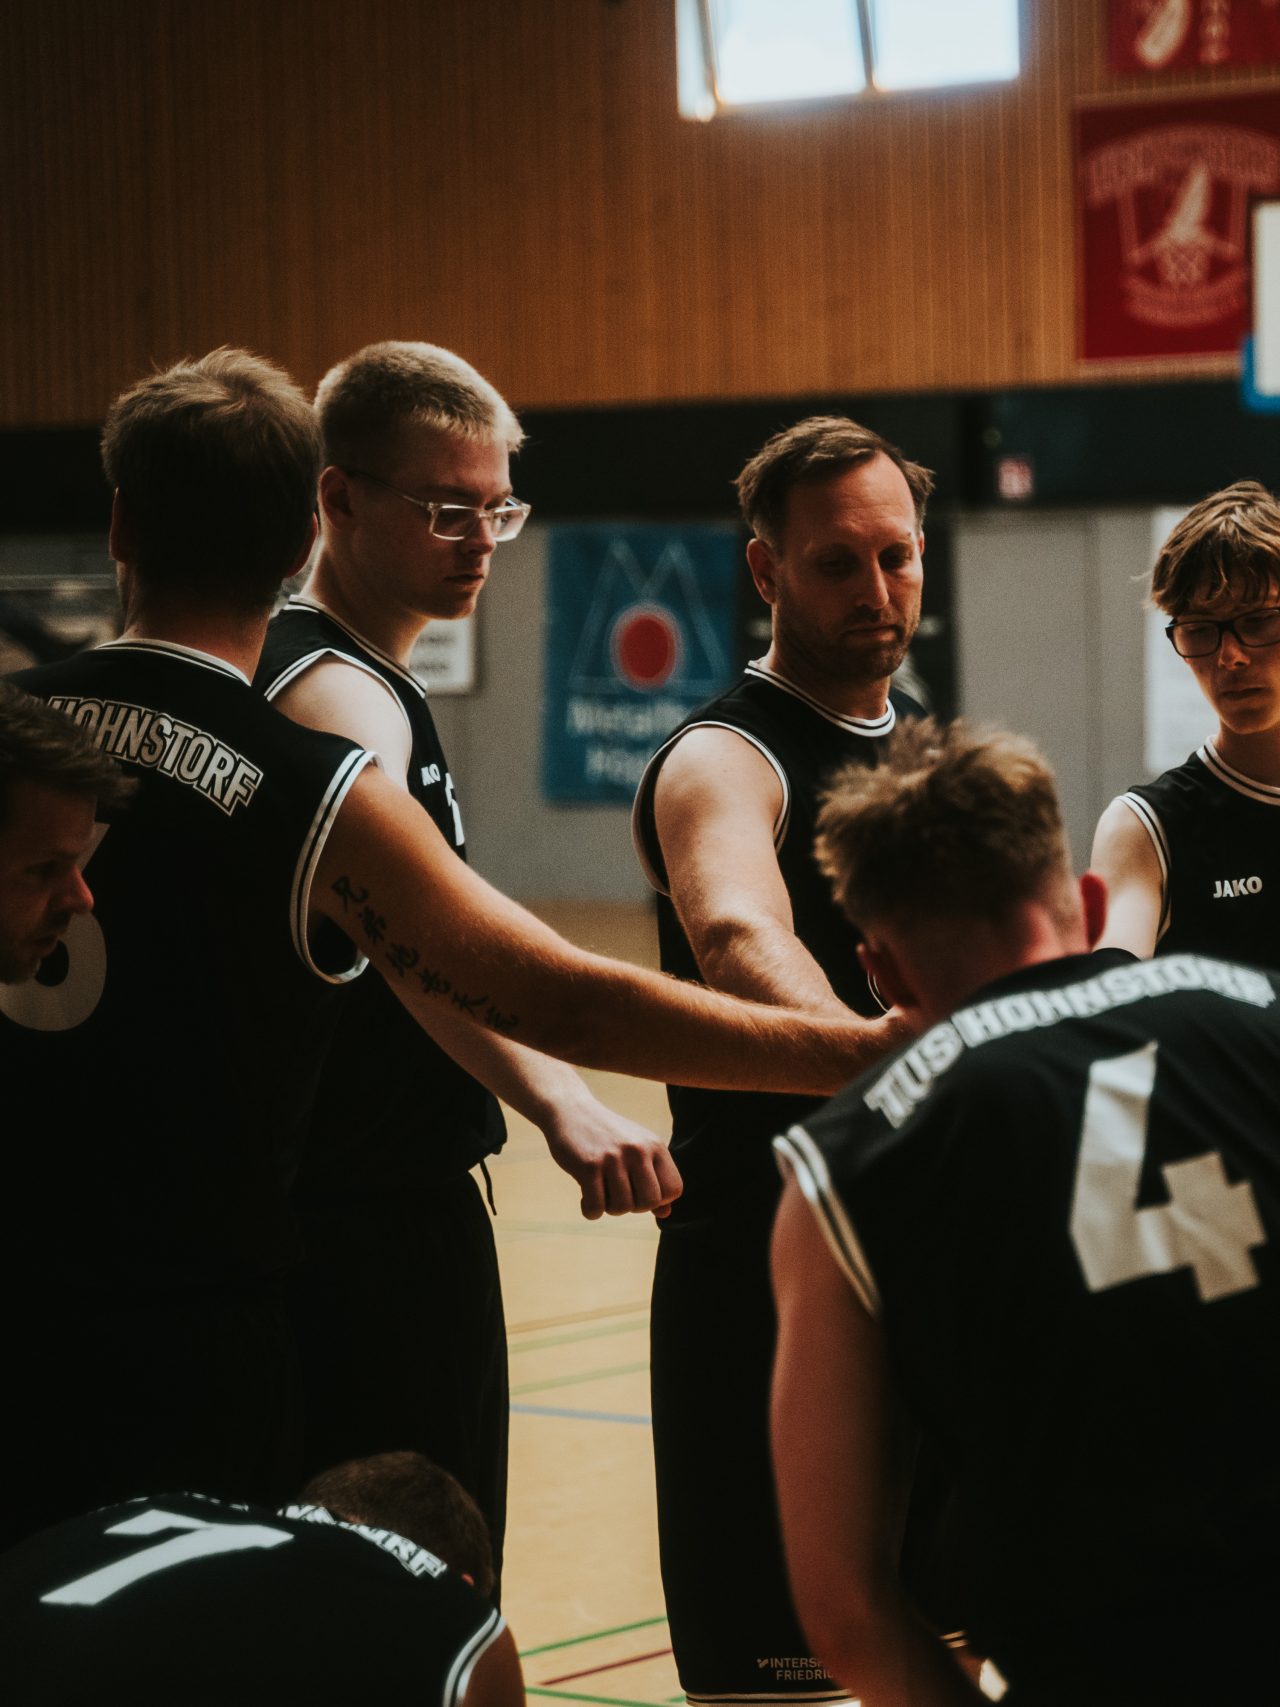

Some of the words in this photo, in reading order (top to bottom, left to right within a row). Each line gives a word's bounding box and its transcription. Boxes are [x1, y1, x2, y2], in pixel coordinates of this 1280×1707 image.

[48, 696, 264, 816] OHNSTORF
[1213, 876, 1263, 898] JAKO
[862, 1020, 966, 1129] TUS
[950, 952, 1277, 1048] HOHNSTORF
[1069, 1039, 1268, 1305] 4
[39, 1509, 295, 1606] 7
